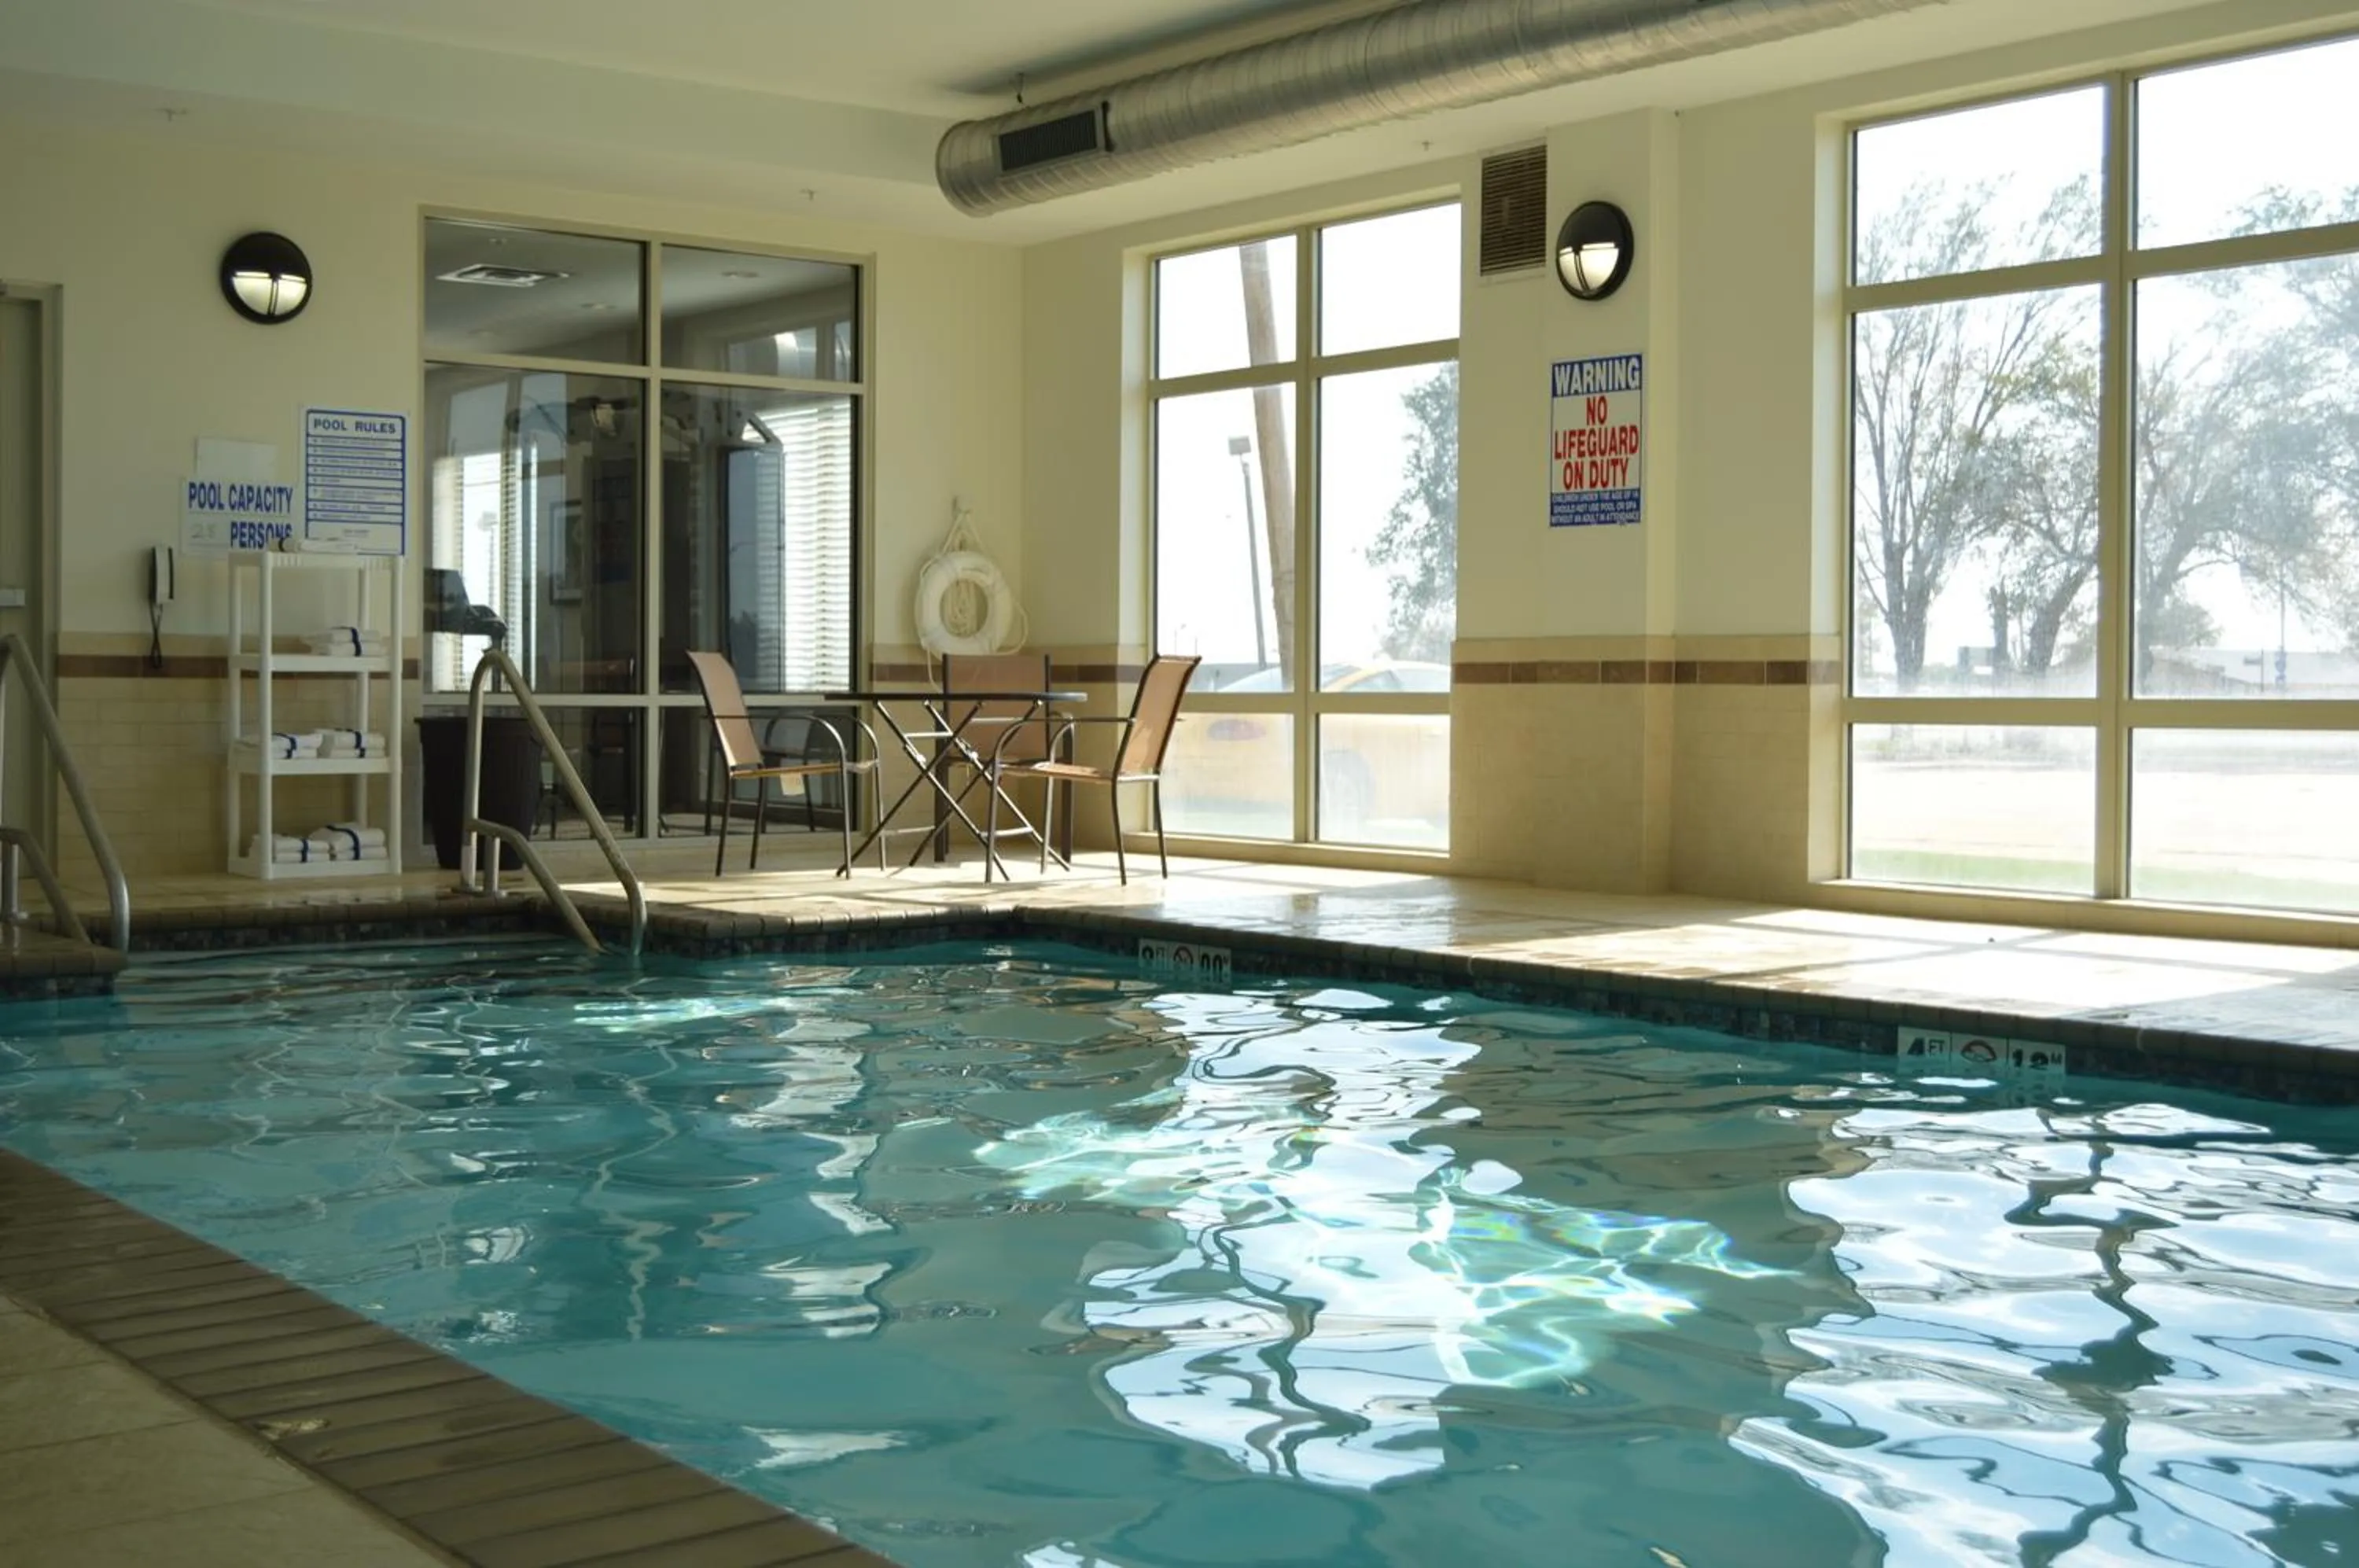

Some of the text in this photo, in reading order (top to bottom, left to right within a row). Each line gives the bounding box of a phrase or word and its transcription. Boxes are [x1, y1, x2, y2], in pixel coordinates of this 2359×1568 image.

[1555, 358, 1640, 396] WARNING
[314, 418, 396, 434] POOL RULES
[1586, 396, 1607, 425] NO
[1554, 425, 1639, 460] LIFEGUARD
[1563, 458, 1628, 491] ON DUTY
[188, 481, 293, 513] POOL CAPACITY
[230, 521, 293, 550] PERSONS
